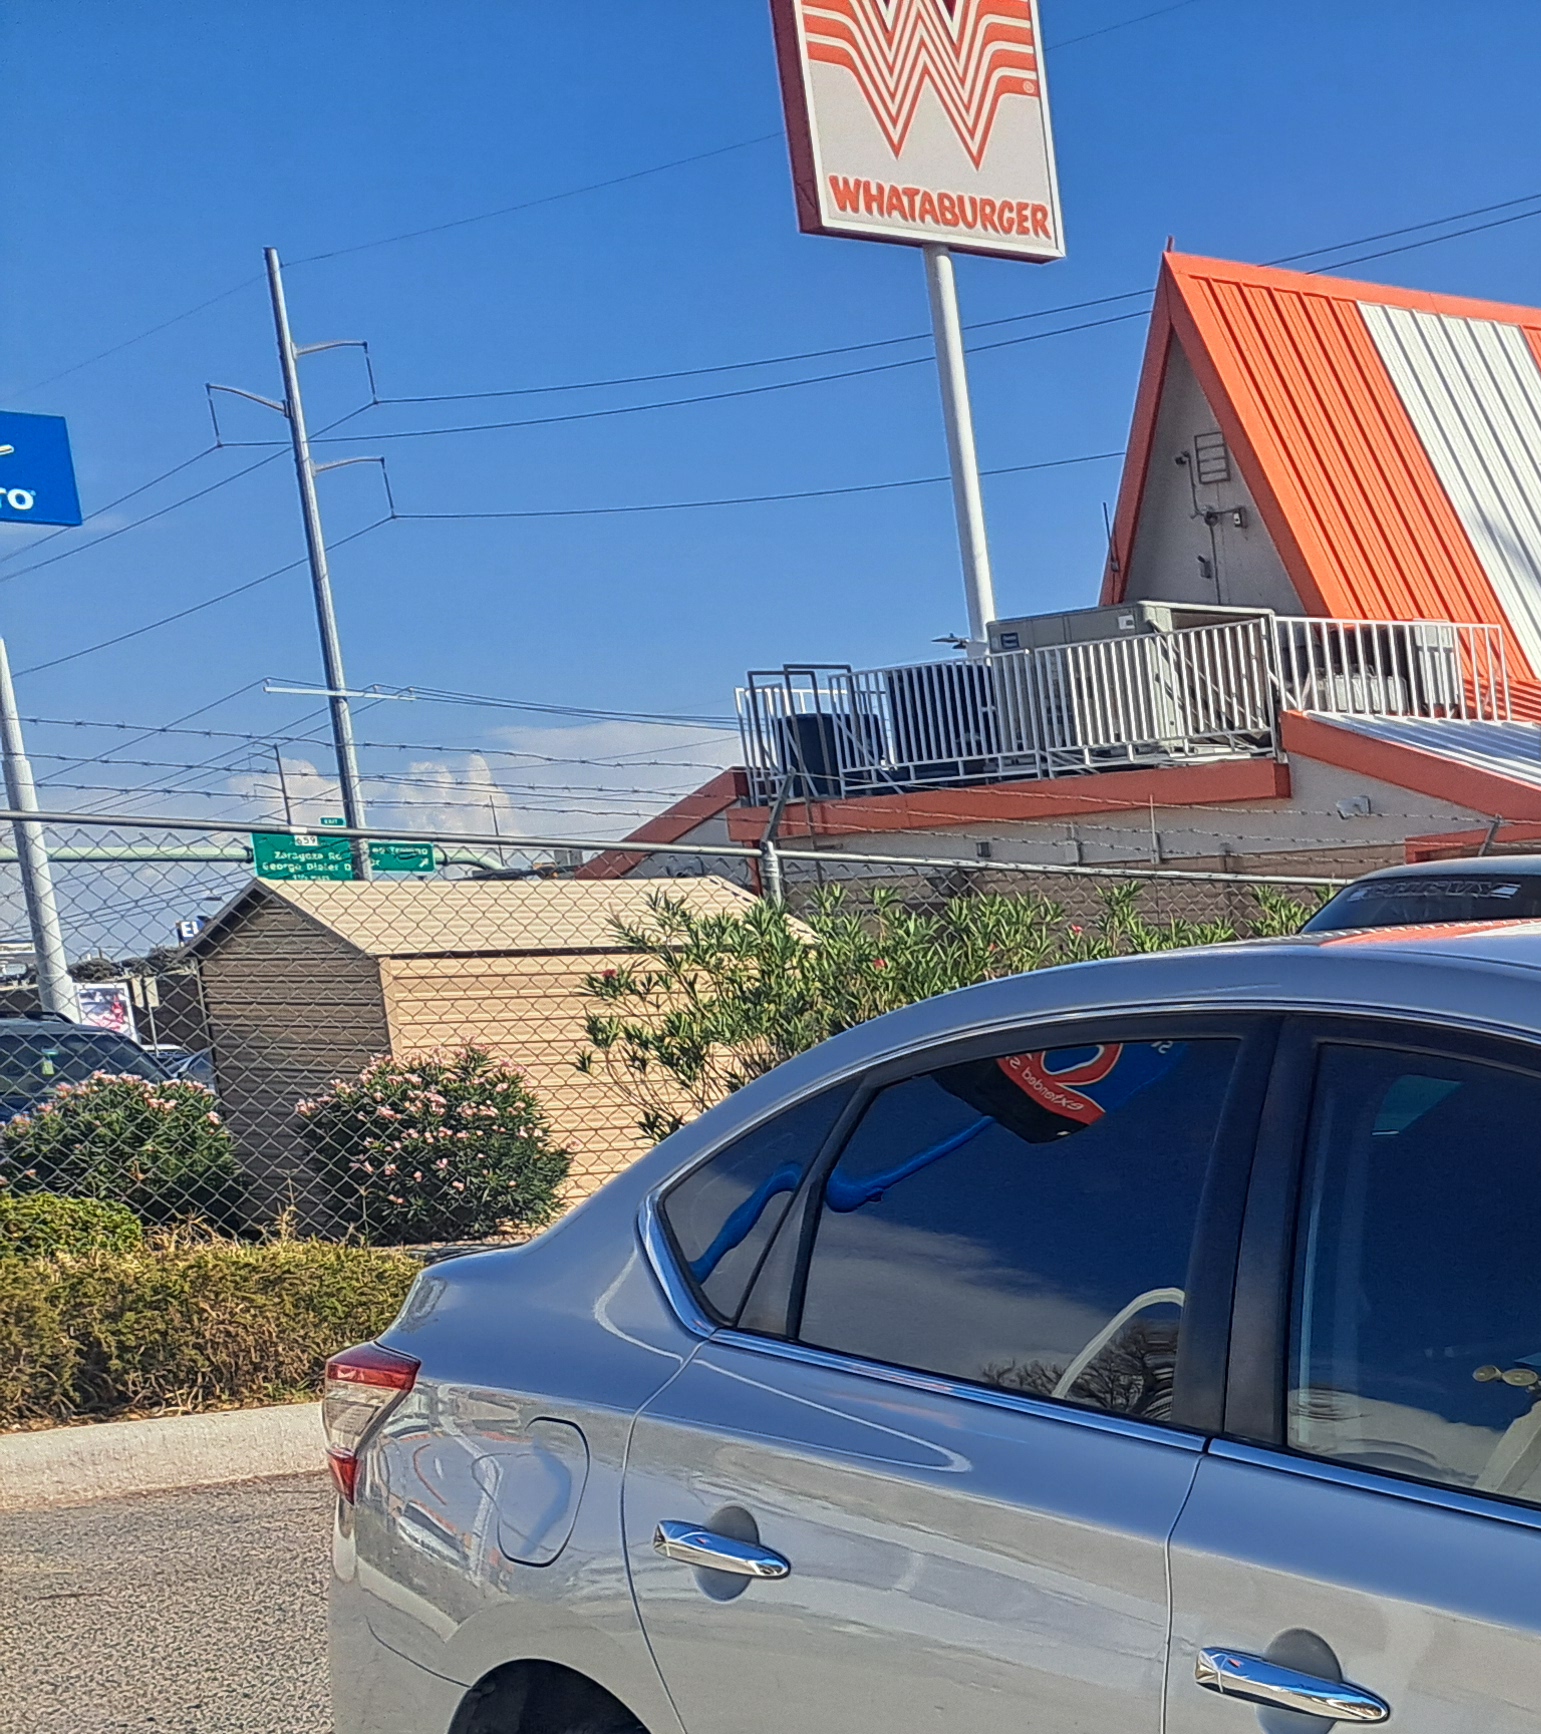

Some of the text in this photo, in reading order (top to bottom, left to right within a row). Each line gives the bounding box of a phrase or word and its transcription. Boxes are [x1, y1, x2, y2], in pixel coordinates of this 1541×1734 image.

[828, 174, 1052, 240] WHATABURGER
[295, 836, 316, 845] 659
[274, 851, 324, 862] Zaragoza
